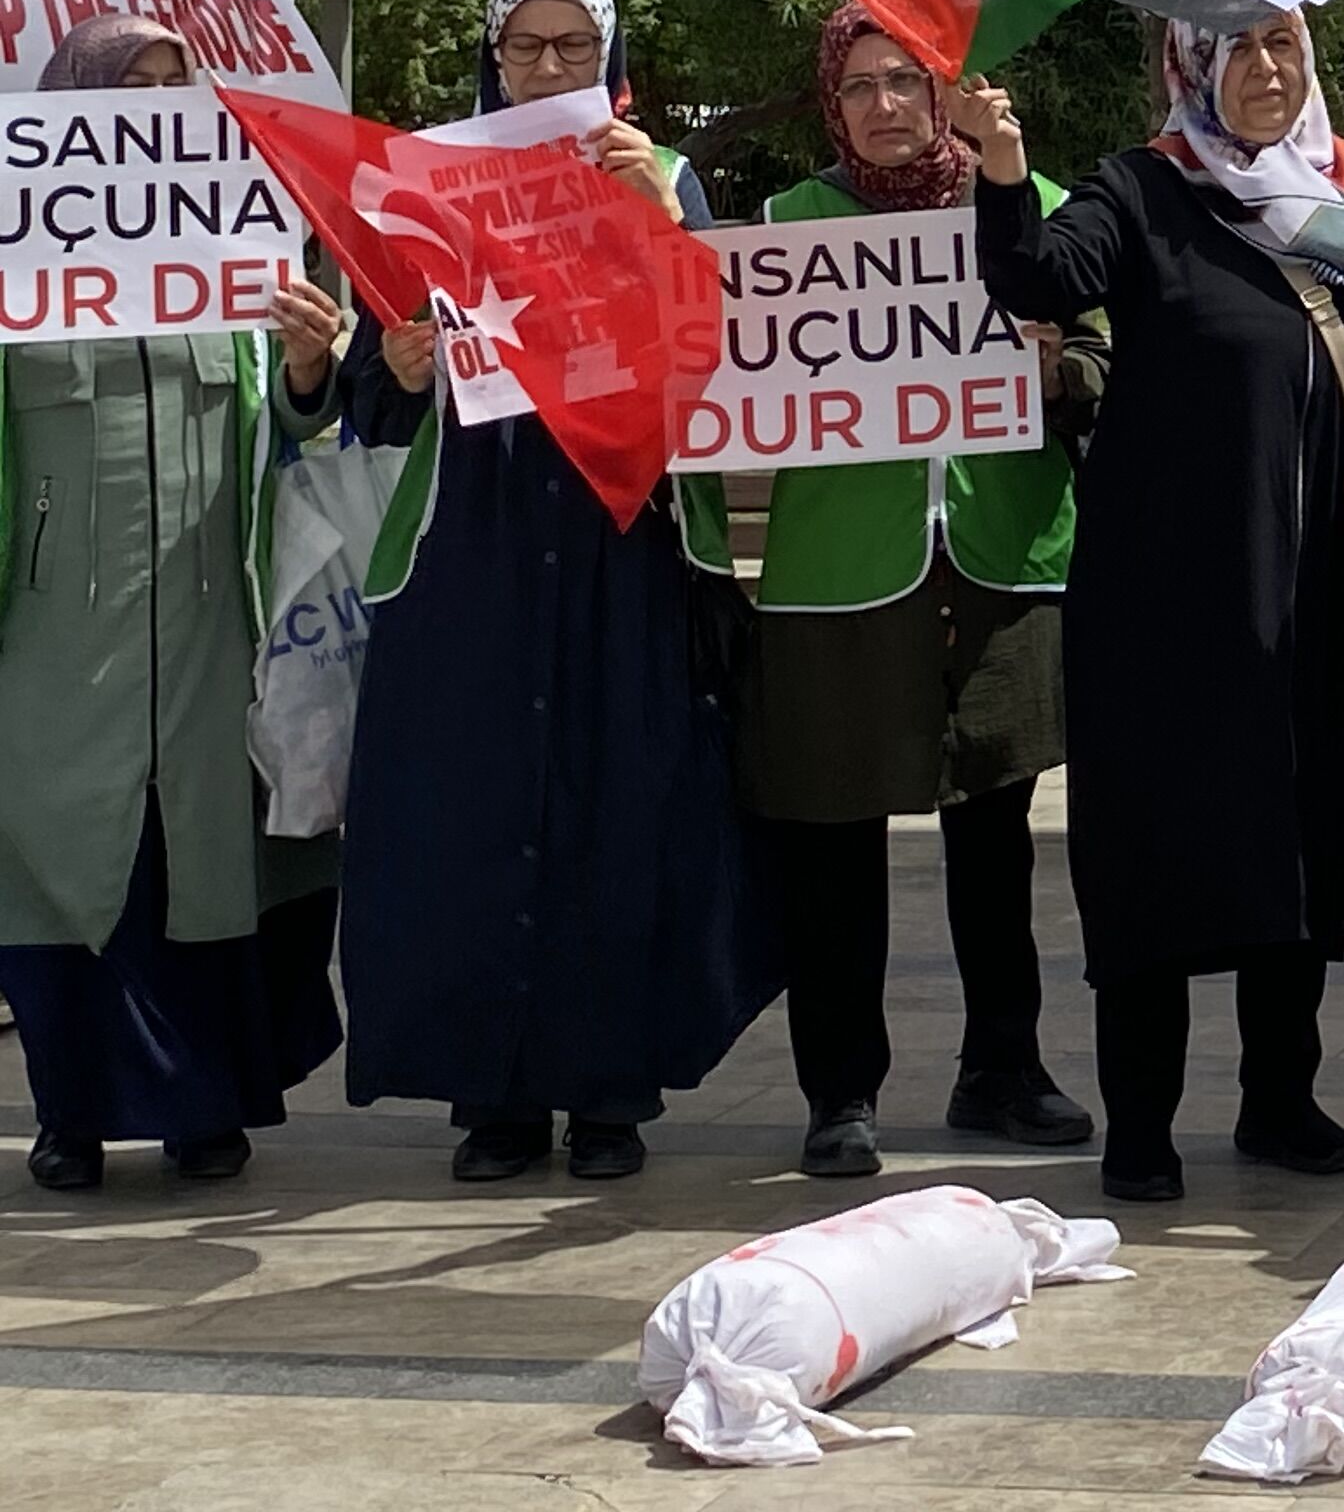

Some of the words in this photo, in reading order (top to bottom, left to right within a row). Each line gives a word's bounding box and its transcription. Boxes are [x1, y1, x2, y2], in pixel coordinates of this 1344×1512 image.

[674, 301, 1025, 378] SUÇUNA
[675, 393, 864, 459] DUR
[896, 375, 1029, 445] DE!
